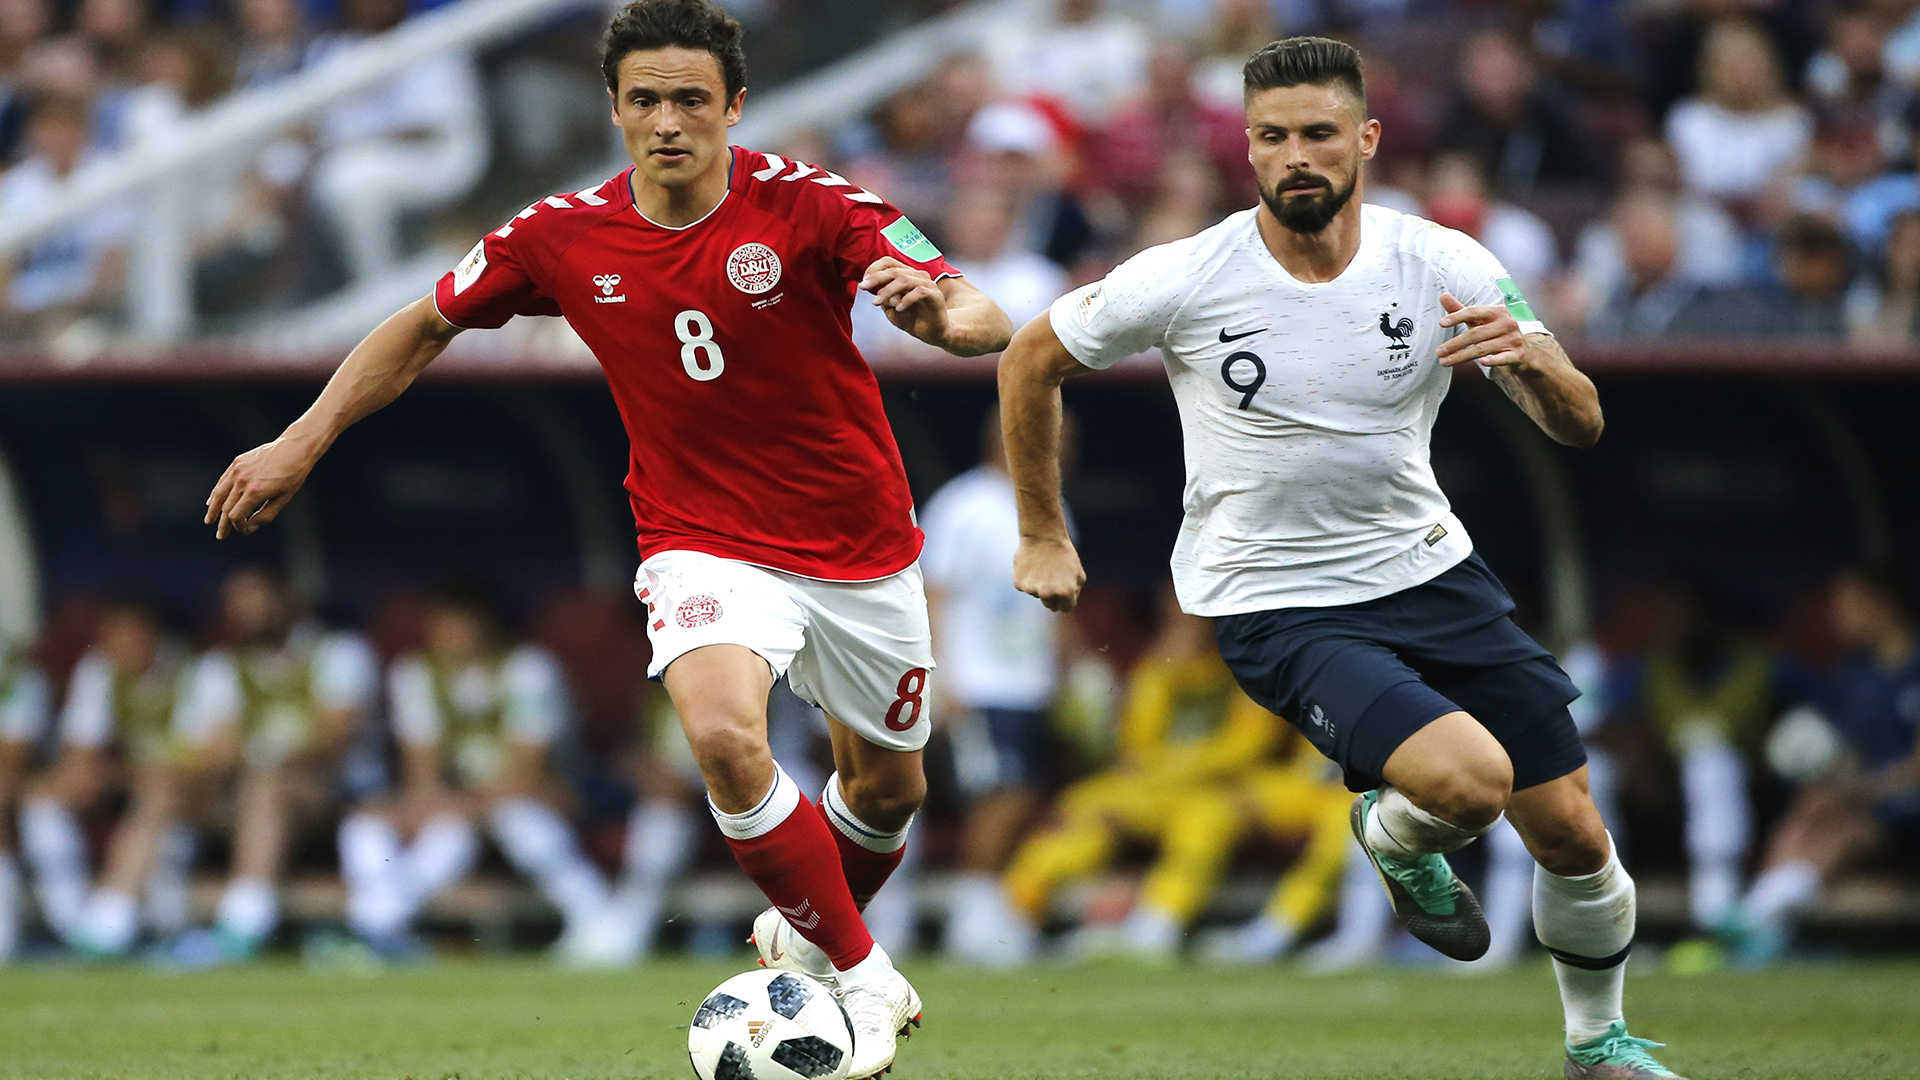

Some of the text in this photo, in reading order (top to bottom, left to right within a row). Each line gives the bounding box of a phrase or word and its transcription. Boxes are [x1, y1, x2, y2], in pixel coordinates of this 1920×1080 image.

[739, 259, 769, 277] DBU
[594, 293, 626, 304] hummel
[674, 309, 725, 382] 8
[1221, 351, 1267, 411] 9
[685, 602, 715, 619] DBU
[885, 667, 925, 732] 8
[753, 1018, 776, 1049] adidas
